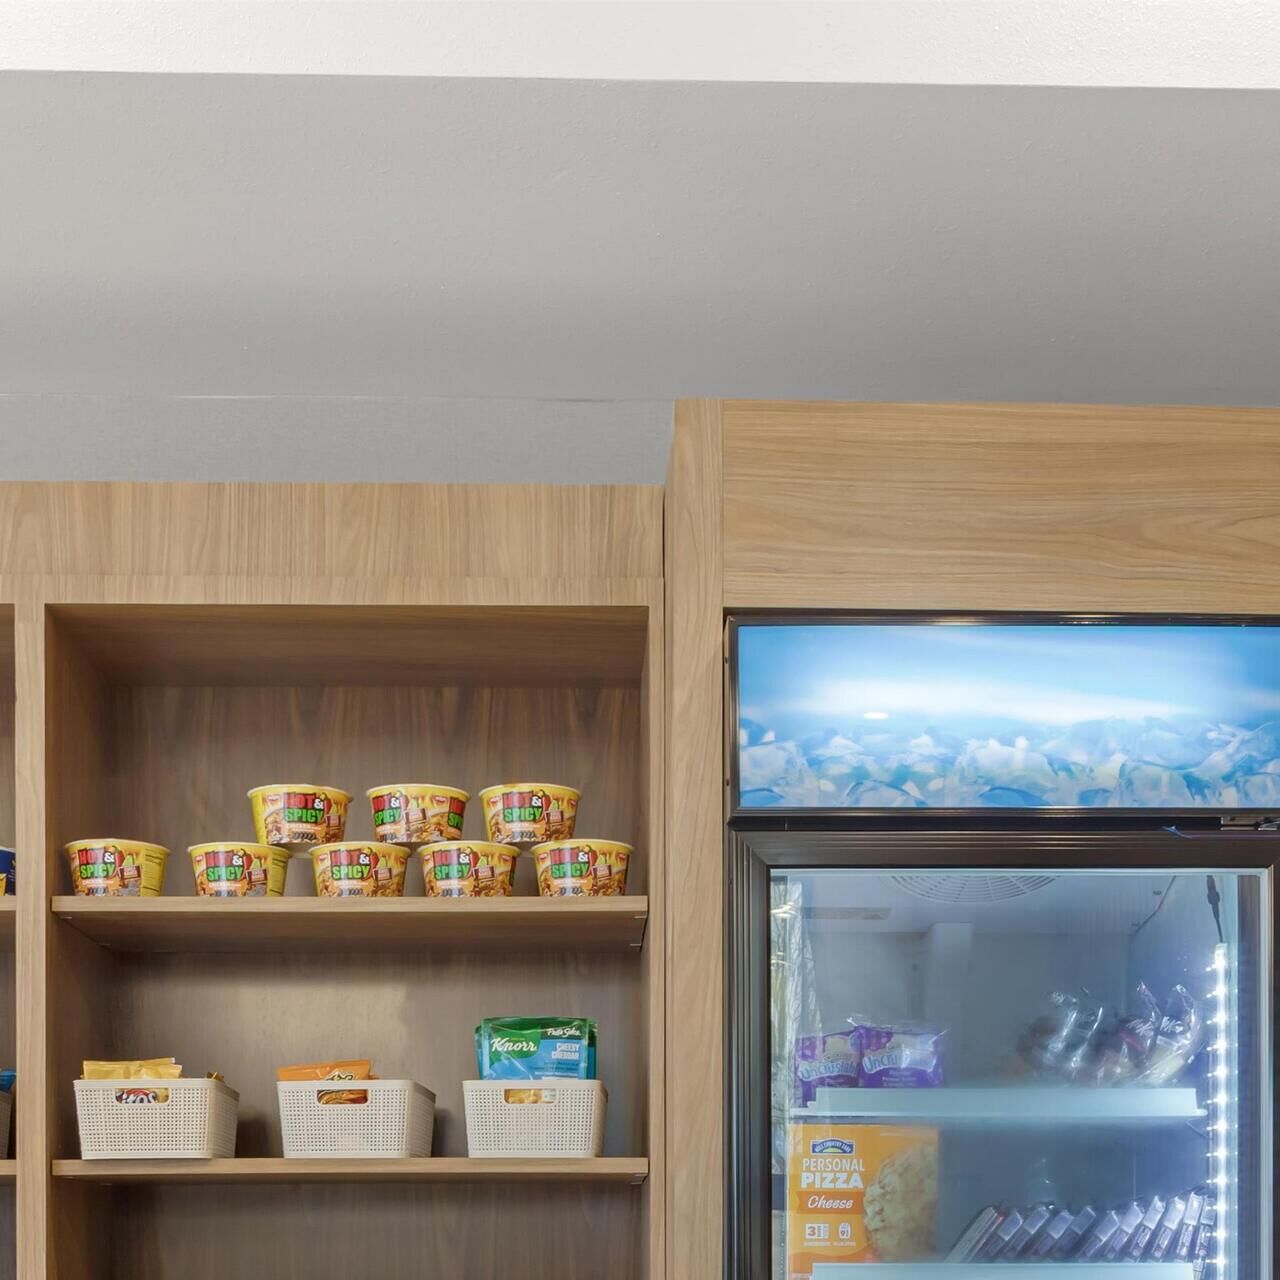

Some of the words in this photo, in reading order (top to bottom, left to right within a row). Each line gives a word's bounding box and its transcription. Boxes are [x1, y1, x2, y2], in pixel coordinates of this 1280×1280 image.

[285, 793, 314, 809] HOT
[314, 798, 324, 809] &
[372, 795, 392, 811] HOT
[391, 797, 401, 807] &
[503, 791, 532, 808] HOT
[532, 796, 542, 806] &
[285, 809, 323, 822] SPICY
[374, 808, 401, 825] SPICY
[504, 808, 542, 822] SPICY
[79, 849, 104, 864] HOT
[104, 851, 115, 862] &
[205, 851, 233, 866] HOT
[232, 855, 242, 866] &
[331, 851, 360, 865] HOT
[359, 854, 370, 864] &
[434, 851, 459, 865] HOT
[459, 853, 470, 864] &
[550, 849, 578, 865] HOT
[577, 852, 588, 862] &
[80, 863, 115, 878] SPICY
[207, 866, 242, 881] SPICY
[332, 865, 370, 880] SPICY
[434, 865, 469, 880] SPICY
[551, 864, 588, 878] SPICY
[490, 1037, 537, 1051] Knorr
[803, 1158, 865, 1171] PERSONAL
[800, 1172, 864, 1189] PIZZA
[808, 1195, 854, 1209] Cheese
